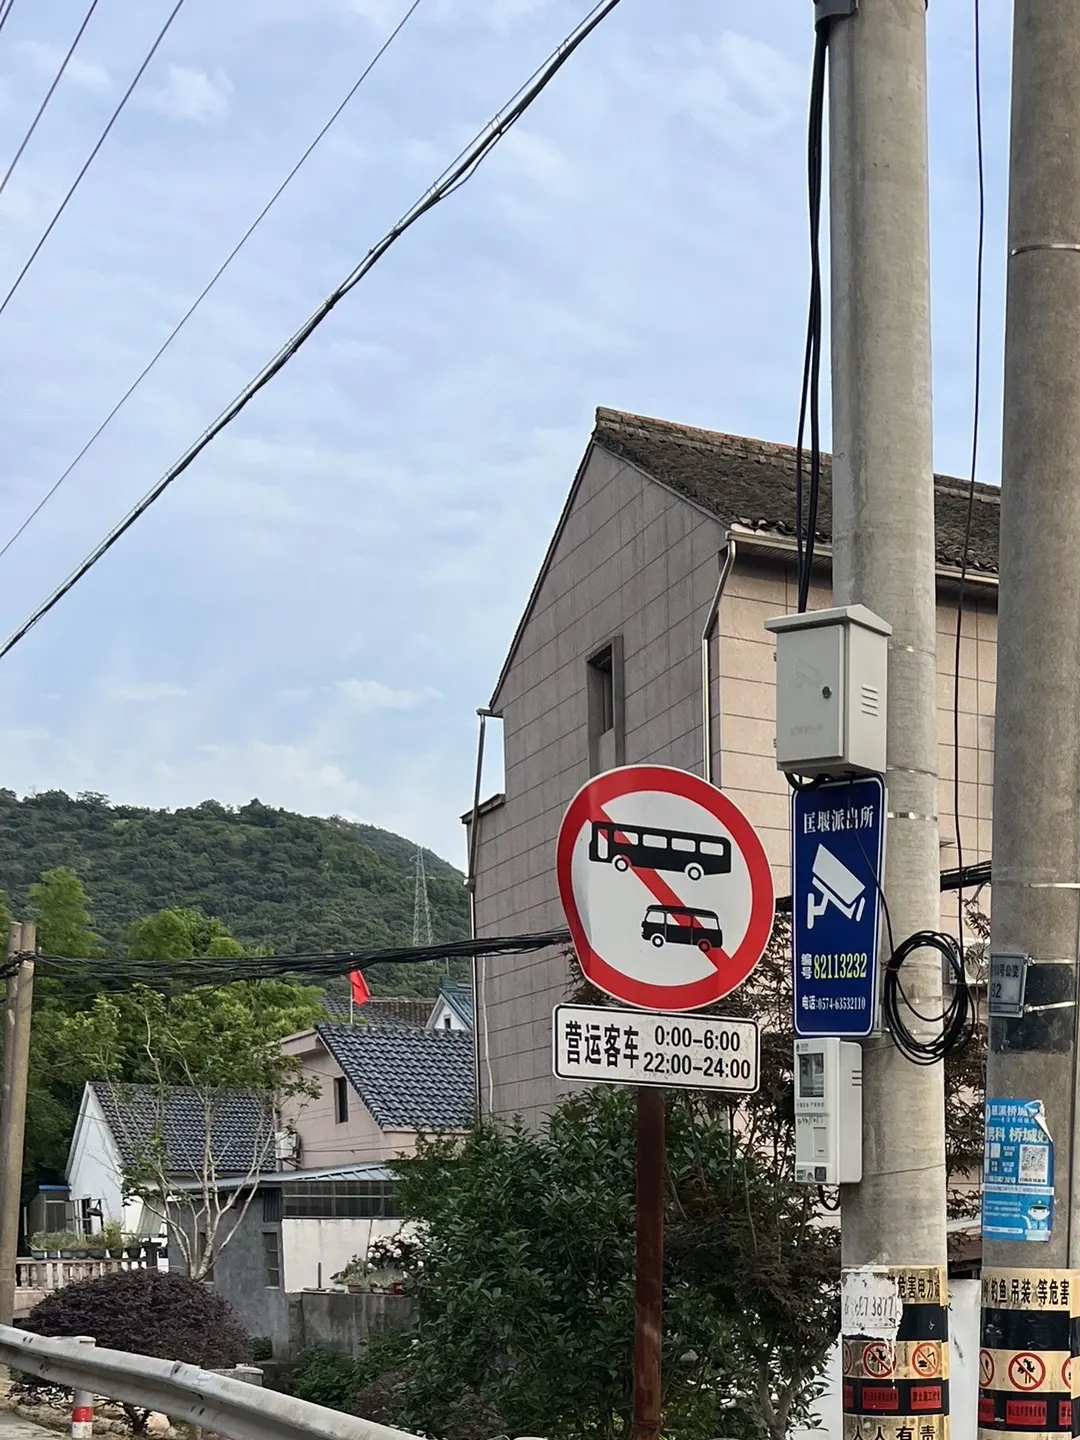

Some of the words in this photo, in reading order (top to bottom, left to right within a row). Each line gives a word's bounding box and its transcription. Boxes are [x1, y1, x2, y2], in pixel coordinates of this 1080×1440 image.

[804, 805, 874, 834] 匡堰派出所
[801, 953, 812, 979] 编号
[814, 953, 867, 979] 82113232
[565, 1020, 639, 1069] 营运客车
